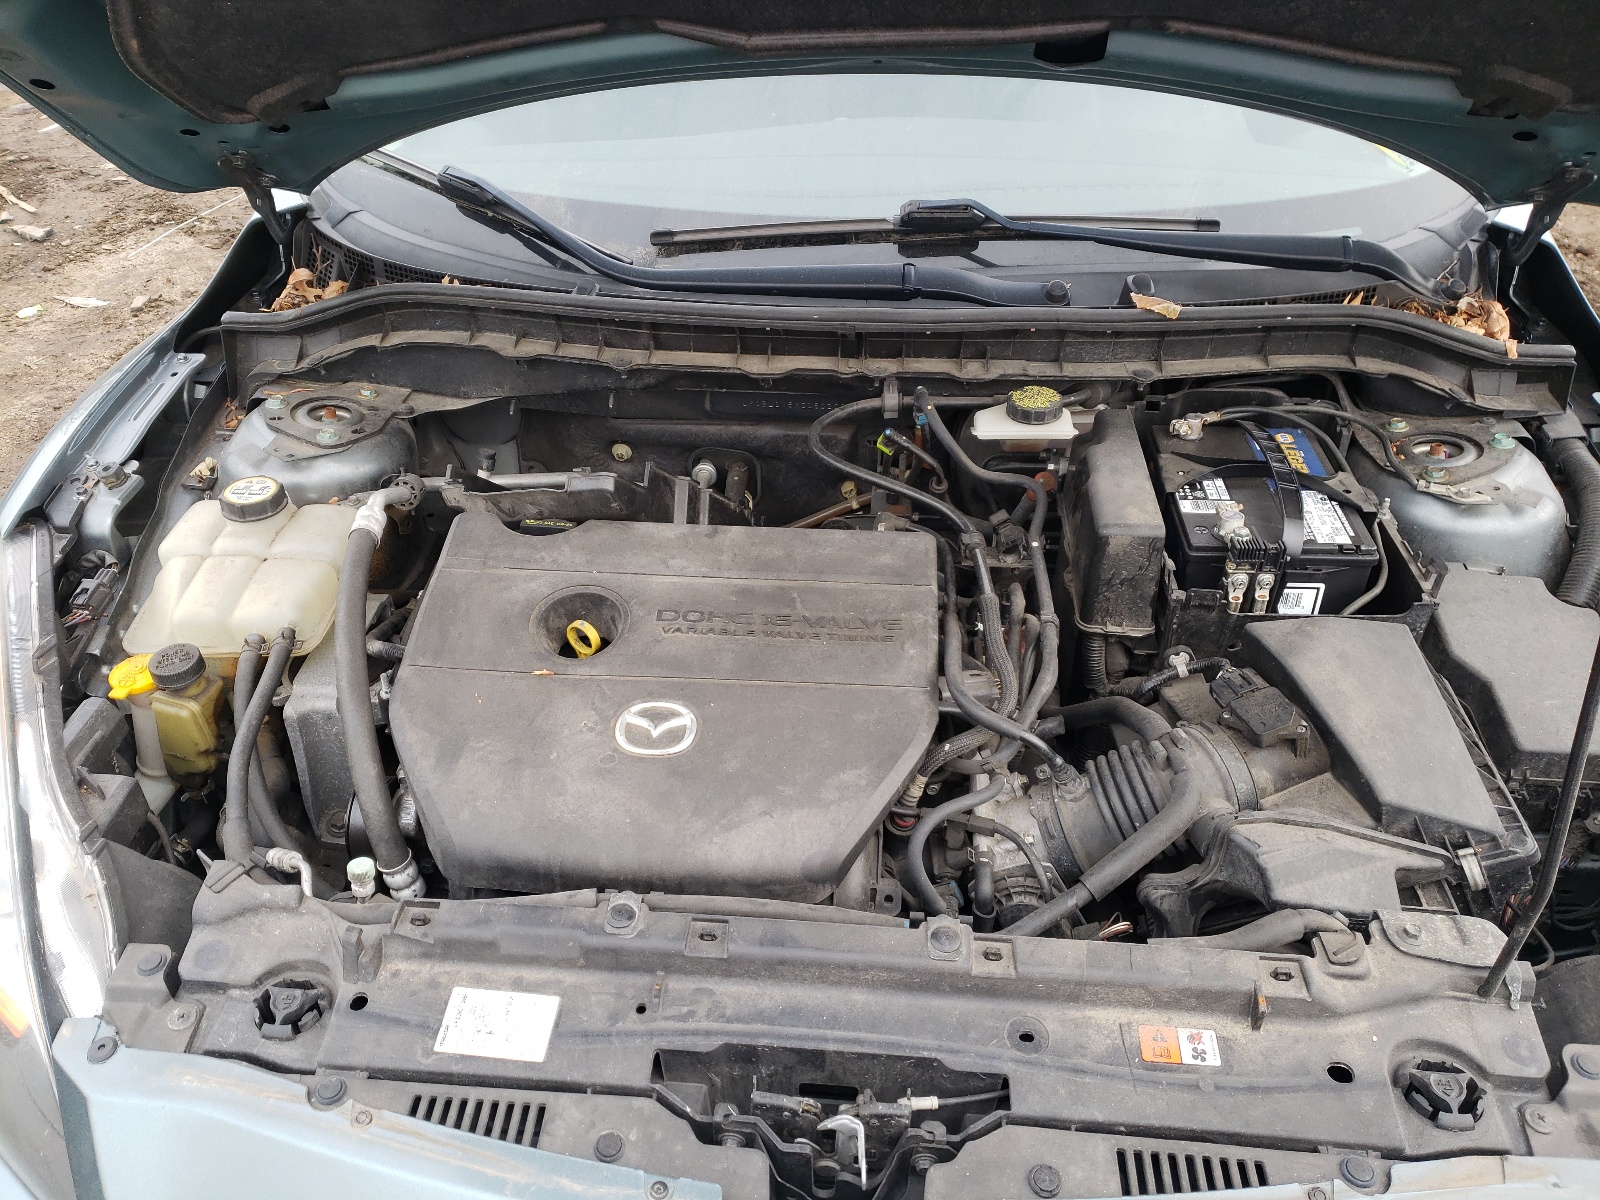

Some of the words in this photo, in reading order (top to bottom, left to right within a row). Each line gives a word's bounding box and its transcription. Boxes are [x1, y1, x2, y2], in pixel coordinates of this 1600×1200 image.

[656, 609, 754, 626] DOHC
[661, 626, 756, 638] VARIABLE
[761, 630, 822, 641] VALVE
[827, 633, 896, 643] TIMING
[161, 648, 184, 660] POWER
